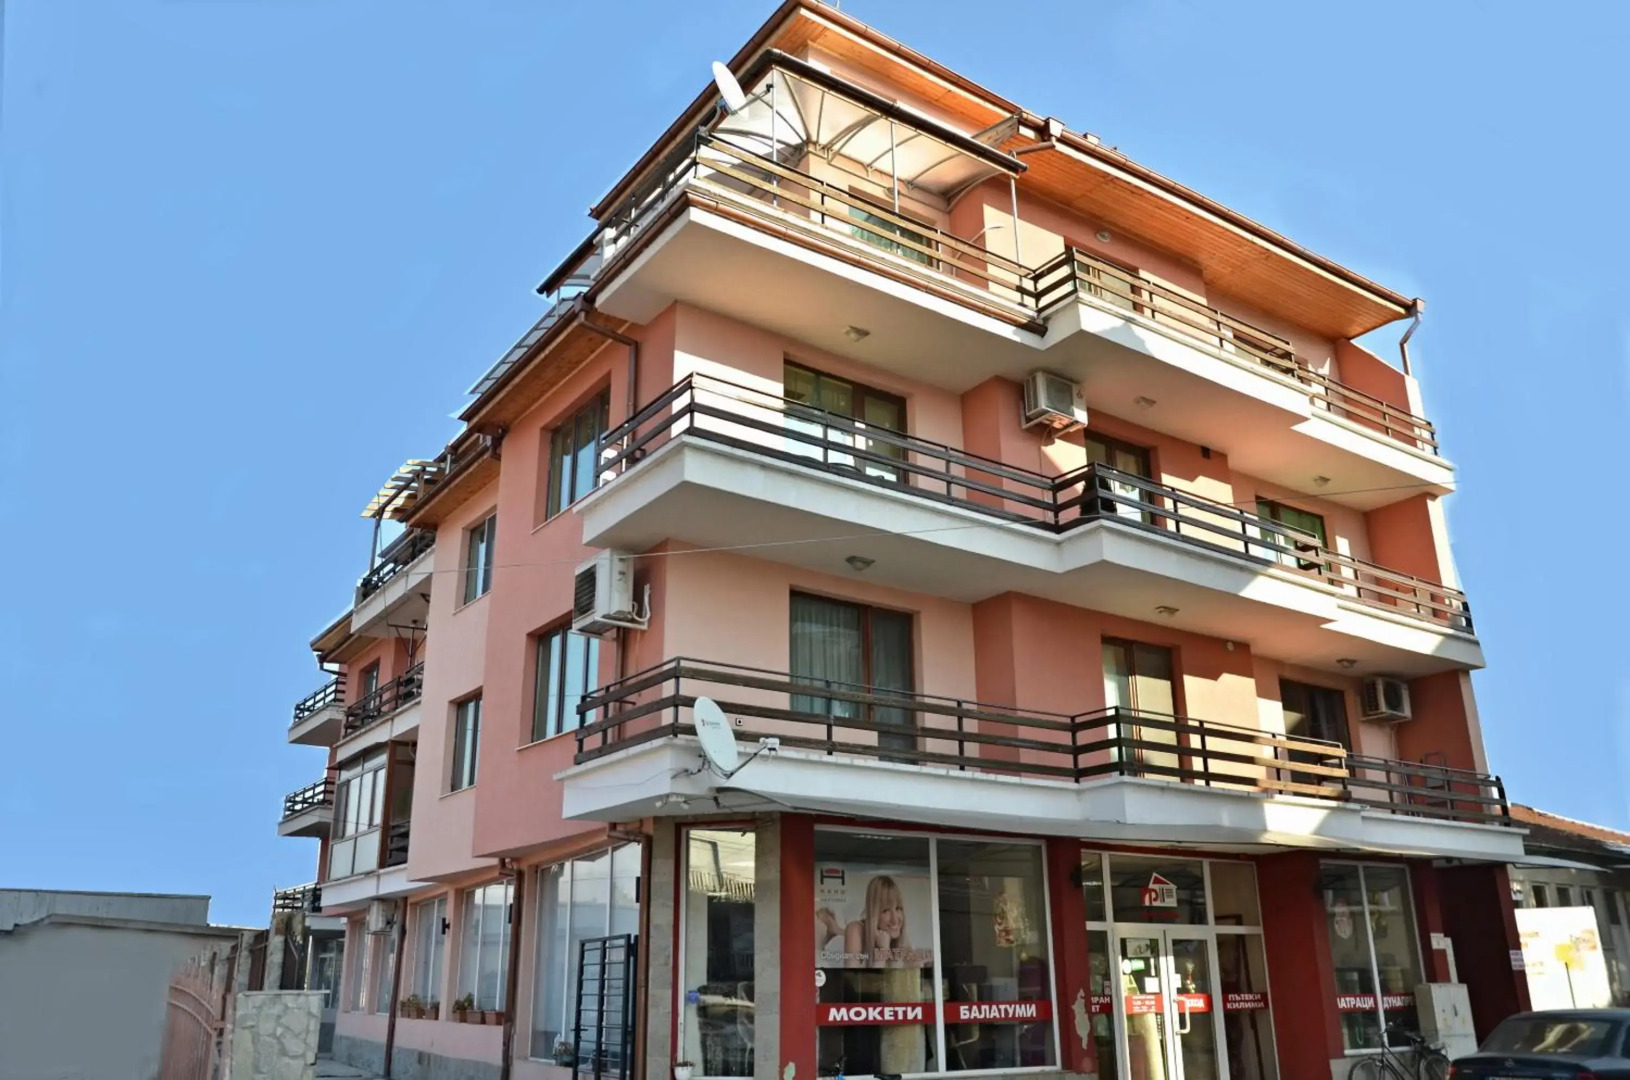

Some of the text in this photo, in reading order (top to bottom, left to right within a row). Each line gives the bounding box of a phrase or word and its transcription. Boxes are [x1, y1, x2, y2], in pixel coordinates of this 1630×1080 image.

[959, 1004, 1037, 1020] БАЛАТУМИ
[1226, 1001, 1265, 1009] КИЛИМИ
[828, 1006, 923, 1021] МОКЕТИ
